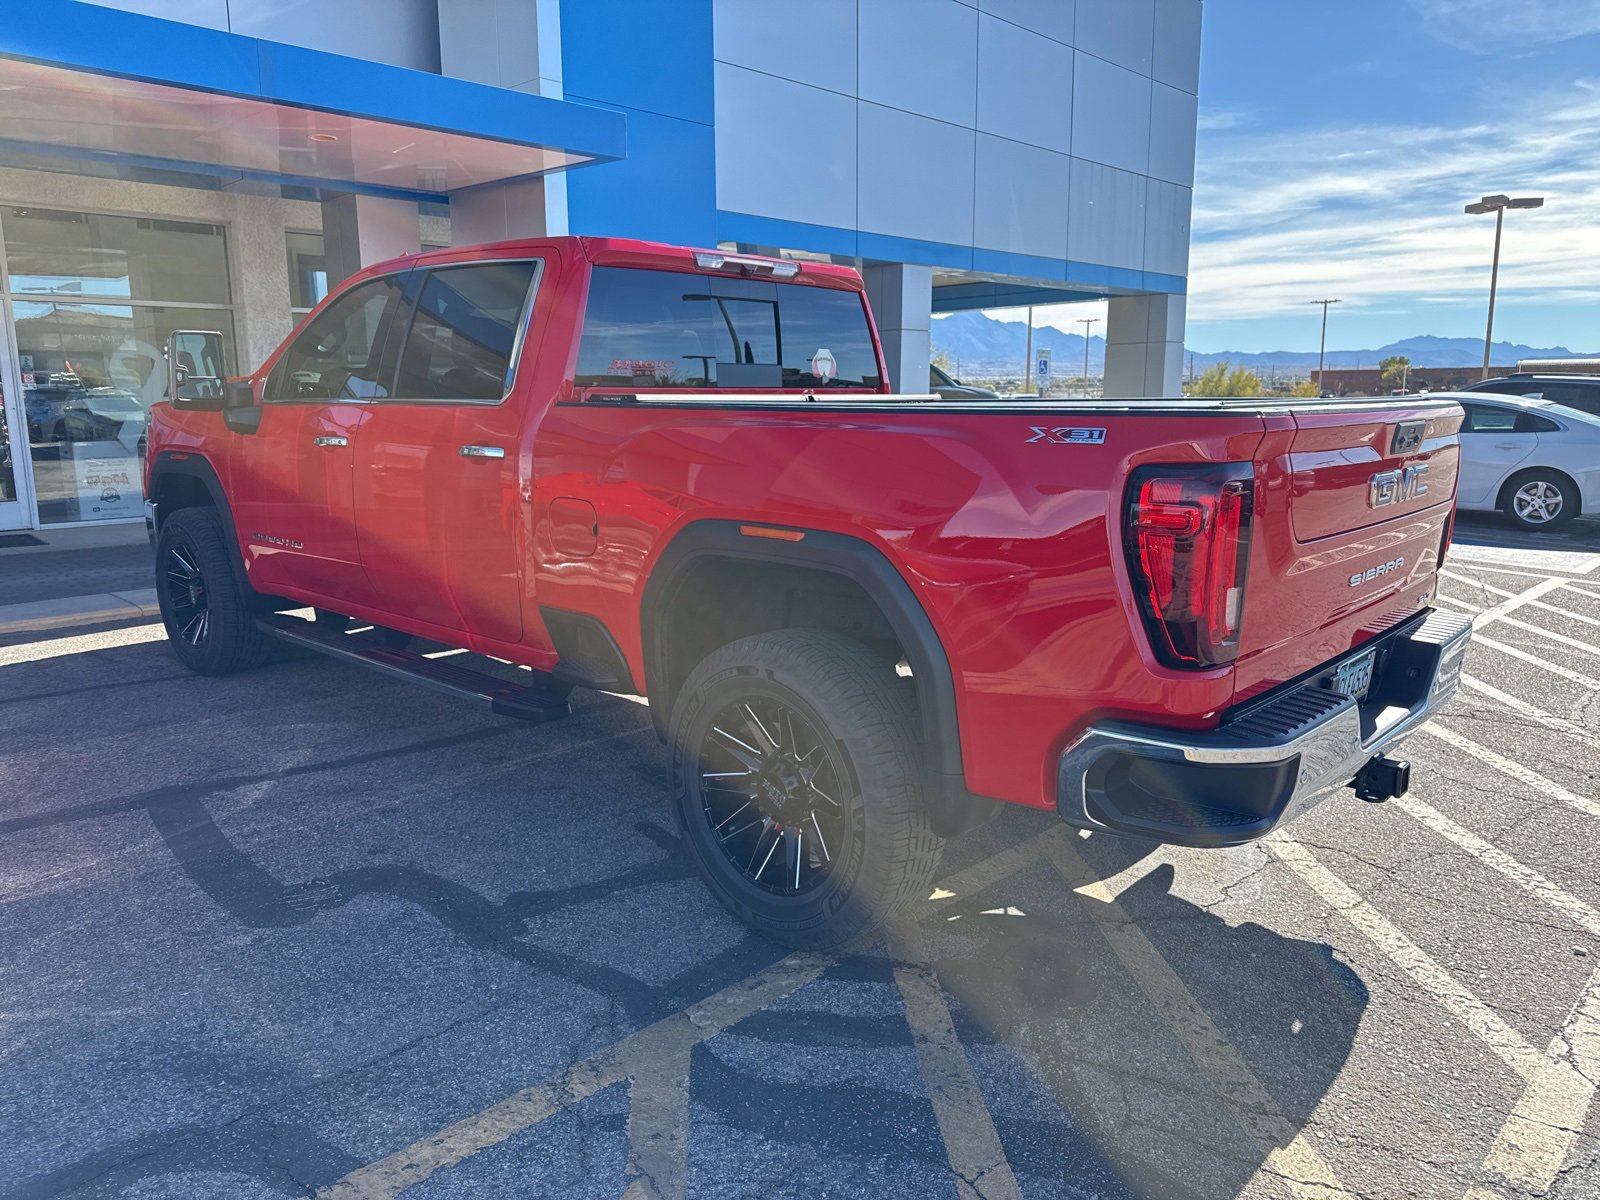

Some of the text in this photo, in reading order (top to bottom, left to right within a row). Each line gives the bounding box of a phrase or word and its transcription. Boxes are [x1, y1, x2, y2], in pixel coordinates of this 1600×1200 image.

[1024, 426, 1107, 444] X31
[1368, 464, 1430, 510] GMC
[1349, 556, 1404, 587] SIERRA
